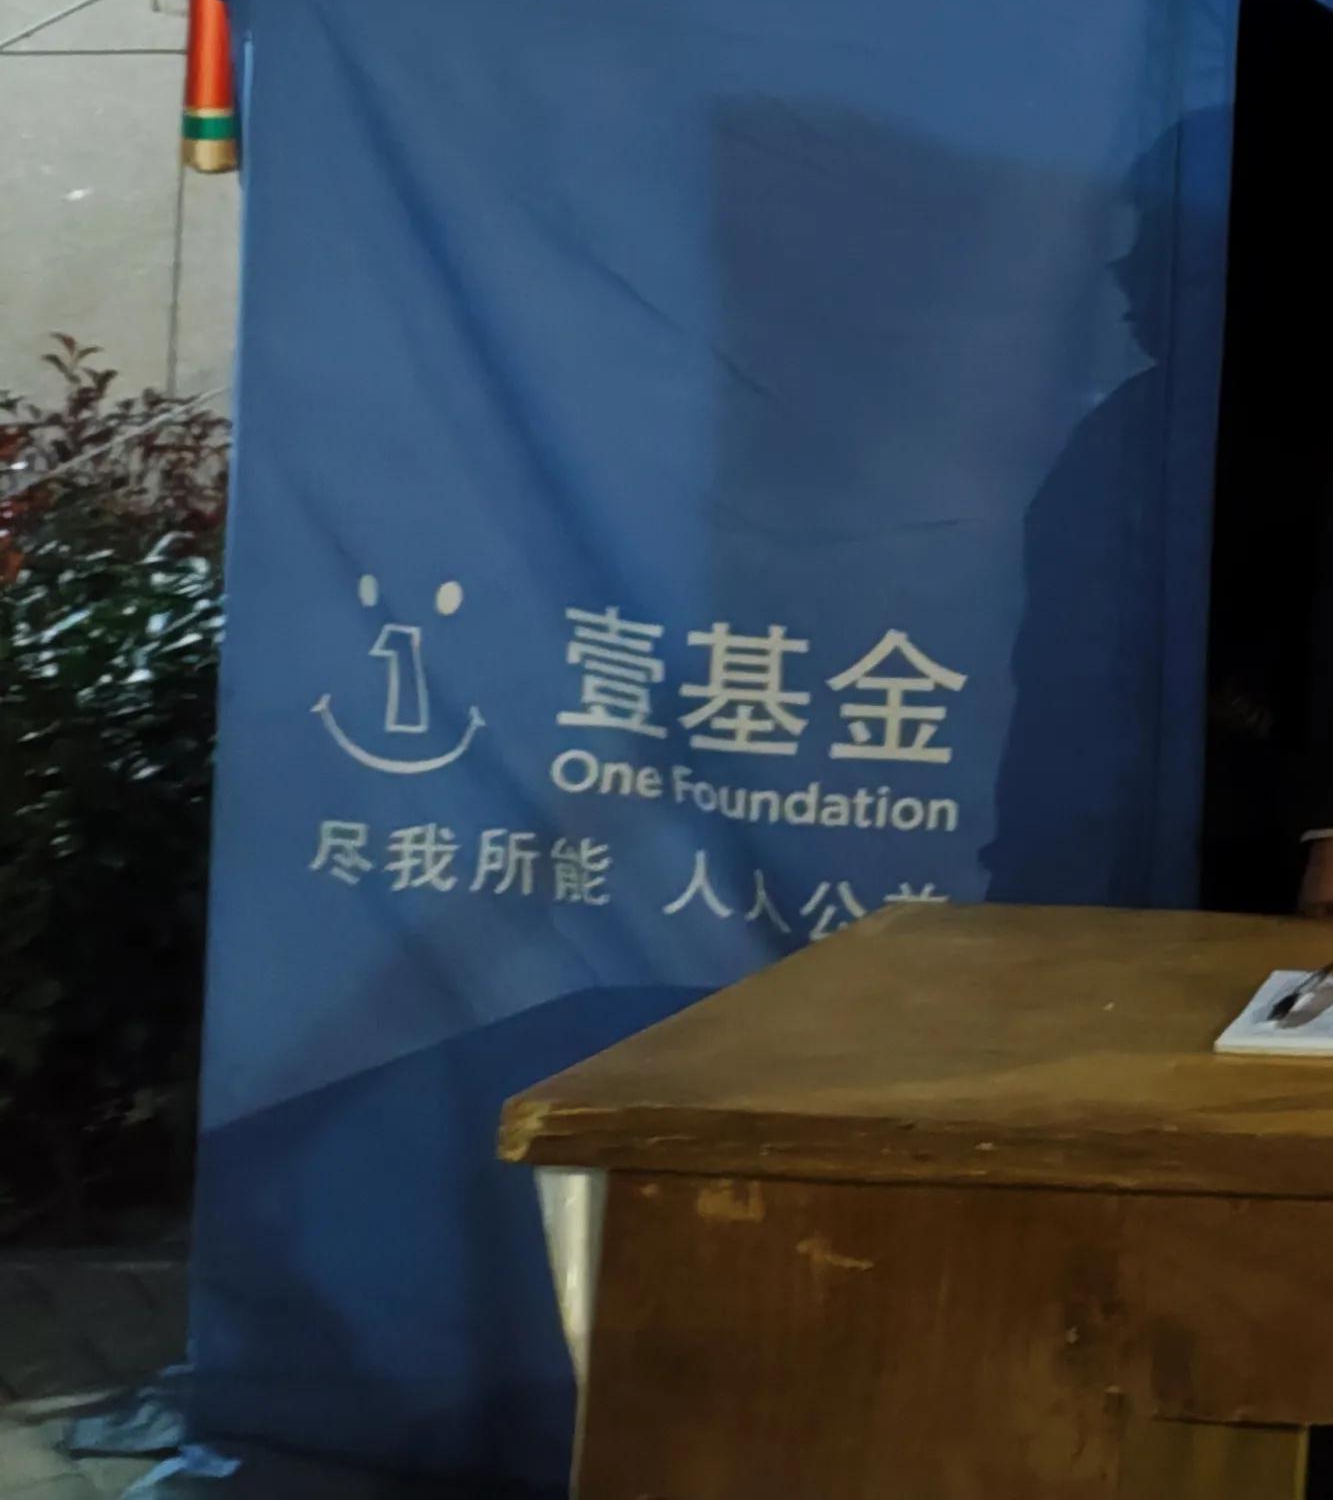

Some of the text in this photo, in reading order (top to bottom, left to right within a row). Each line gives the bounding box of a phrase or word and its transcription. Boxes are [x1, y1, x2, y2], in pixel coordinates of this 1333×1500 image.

[556, 605, 967, 763] 壹基金
[550, 749, 960, 832] One Foundation
[309, 819, 614, 906] 尽我所能
